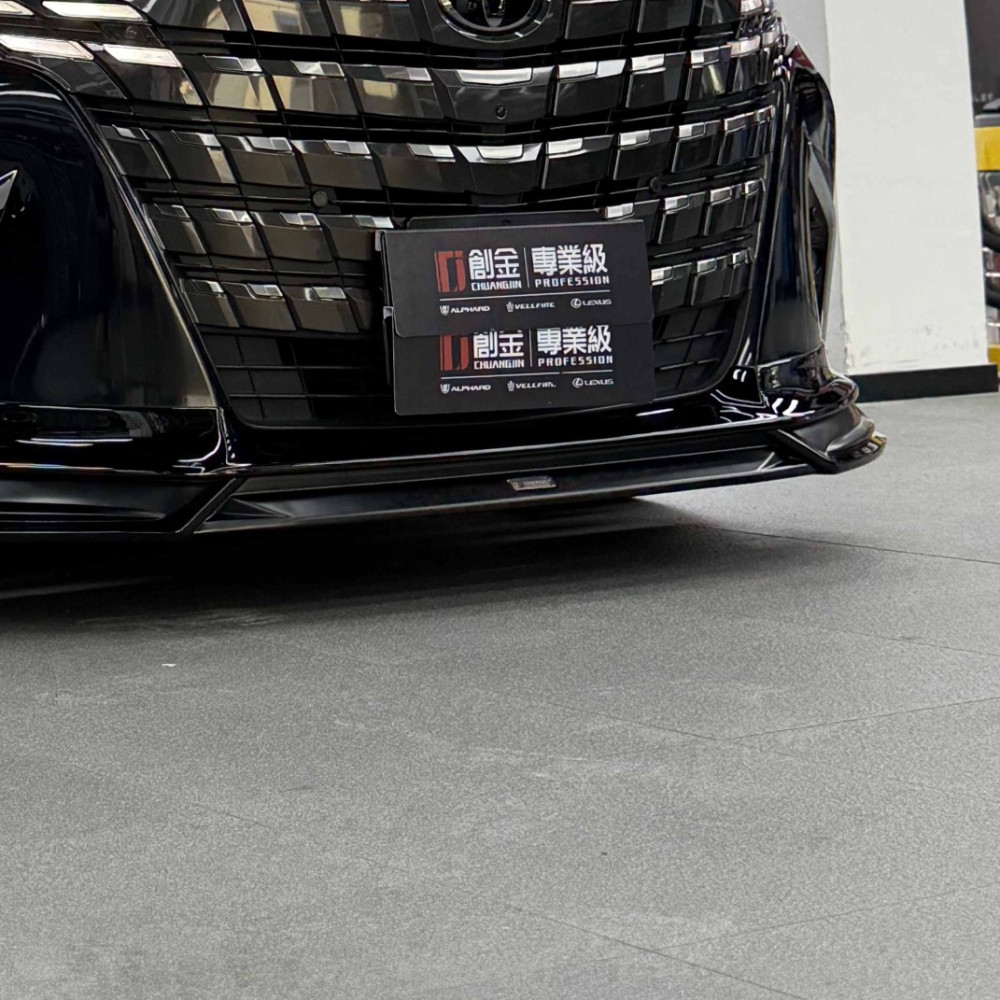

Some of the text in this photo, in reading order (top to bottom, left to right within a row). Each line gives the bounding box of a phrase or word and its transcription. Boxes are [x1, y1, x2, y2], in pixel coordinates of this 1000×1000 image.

[468, 244, 608, 280] 創金 專業級
[471, 276, 610, 291] CHUANGJIN PROFESSION
[451, 306, 490, 314] ALPHARD
[515, 302, 555, 310] VELLFIRE
[473, 325, 612, 358] 創金 專業級
[474, 355, 613, 370] CHUANGJIN PROFESSION
[451, 384, 491, 392] ALPHARD
[584, 378, 614, 386] LEXUS
